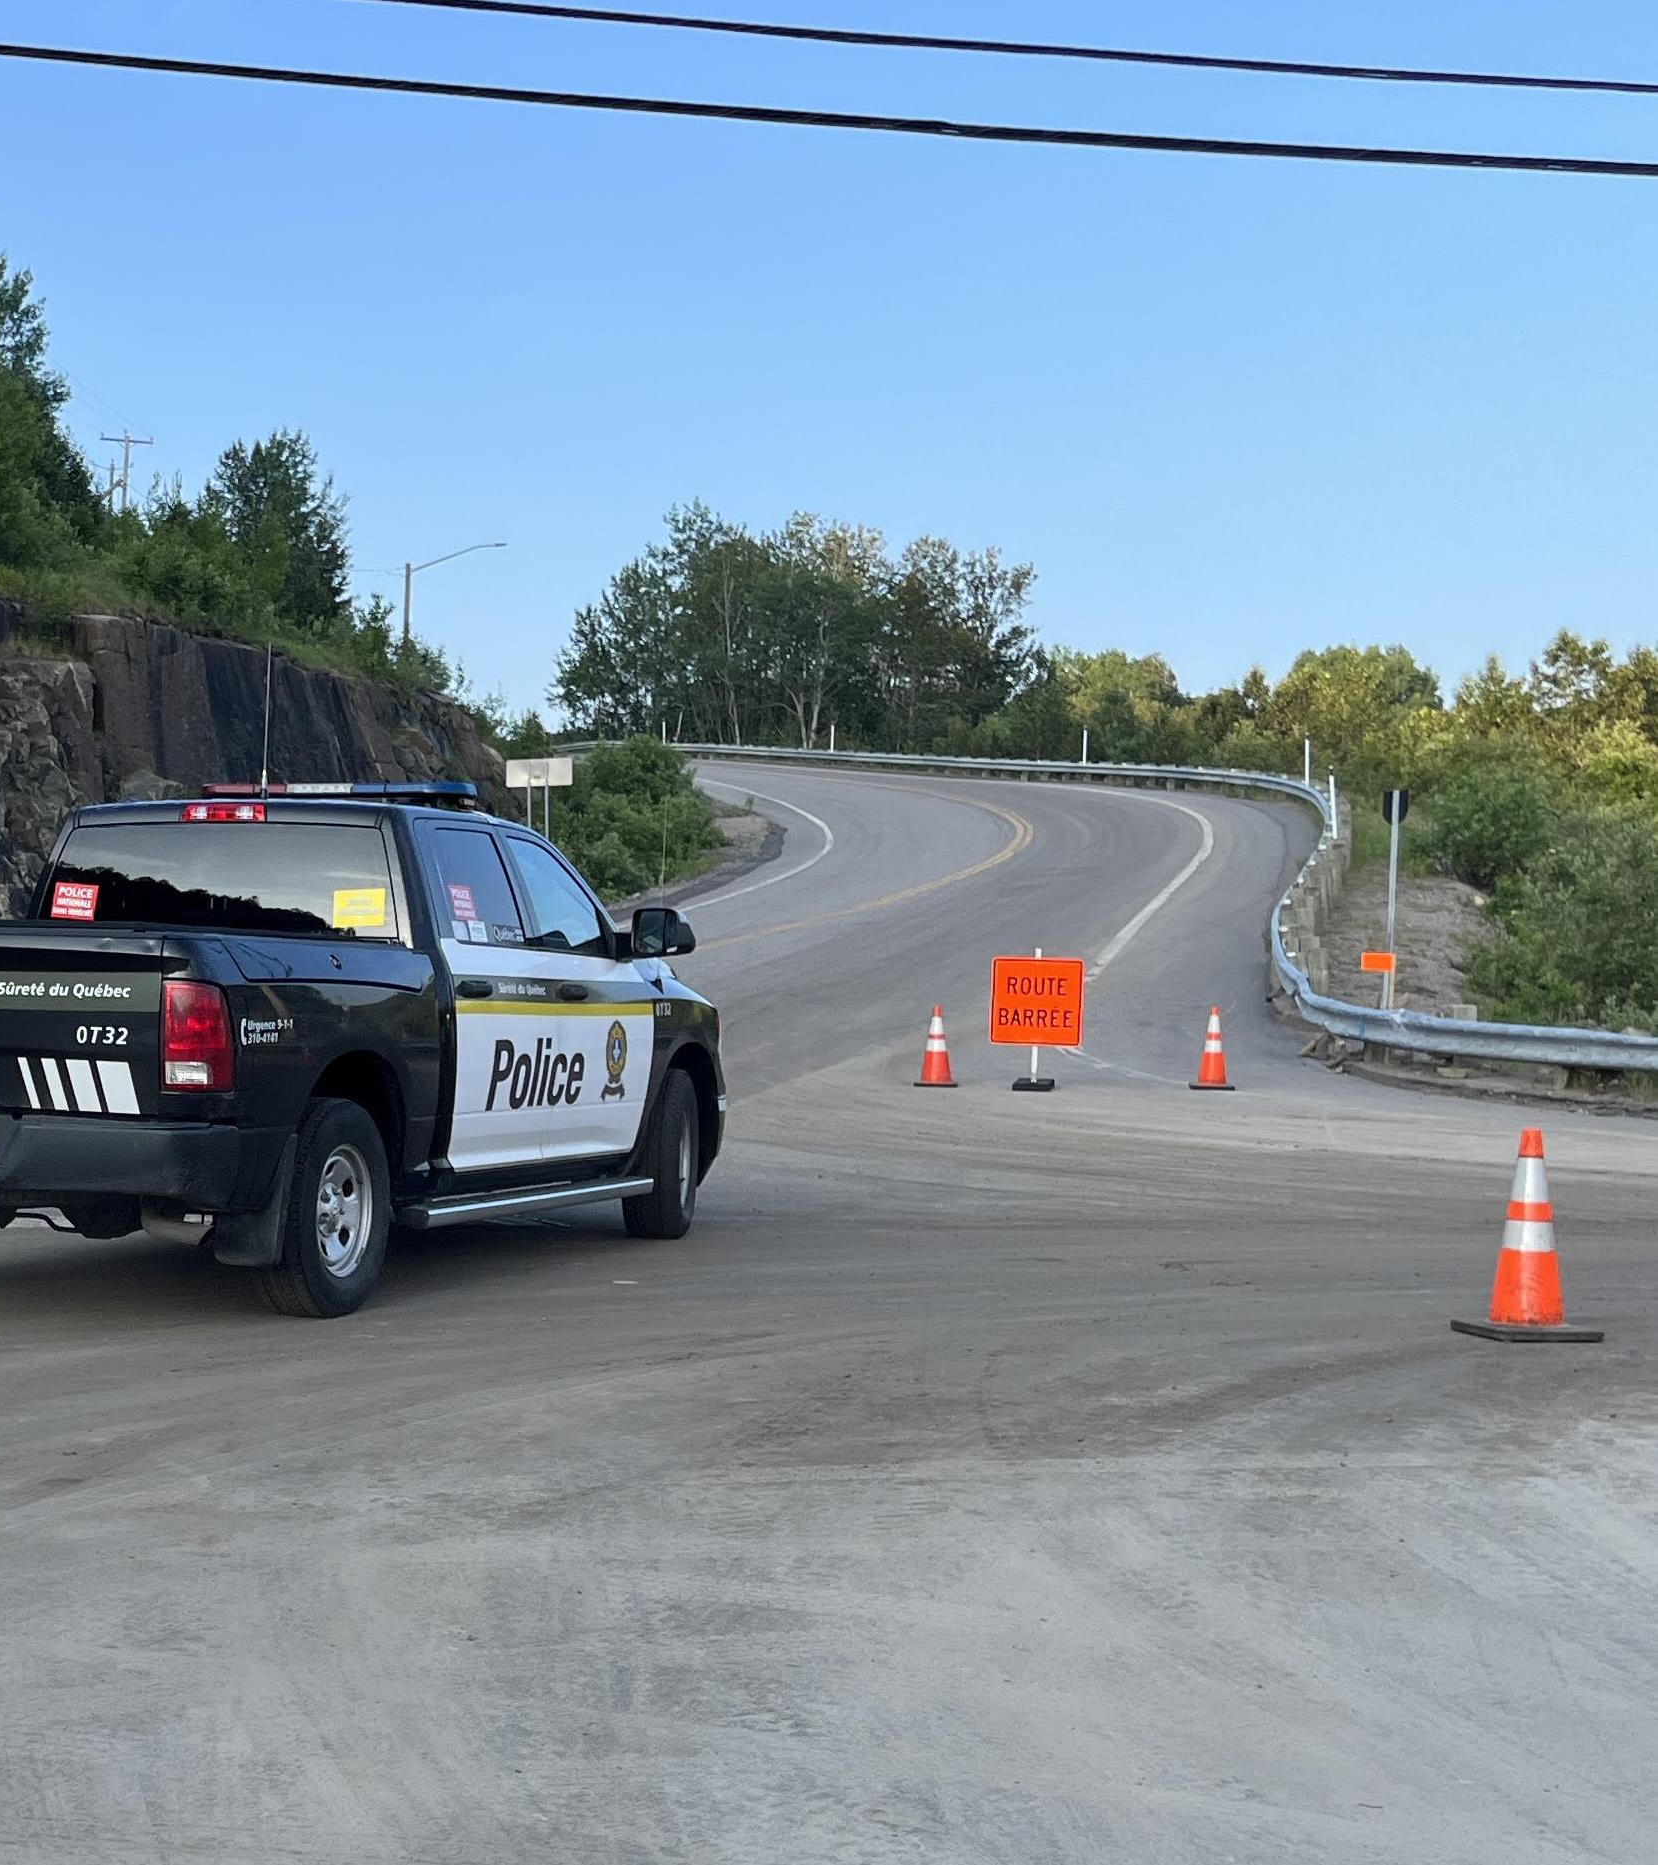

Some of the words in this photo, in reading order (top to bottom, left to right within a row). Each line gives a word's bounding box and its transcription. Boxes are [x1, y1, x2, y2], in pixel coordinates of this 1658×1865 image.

[58, 886, 94, 899] POLICE
[49, 981, 70, 998] du
[73, 981, 132, 1000] Québec
[1007, 976, 1068, 996] ROUTE
[998, 1006, 1074, 1029] BARRÉE
[485, 1037, 585, 1111] Police
